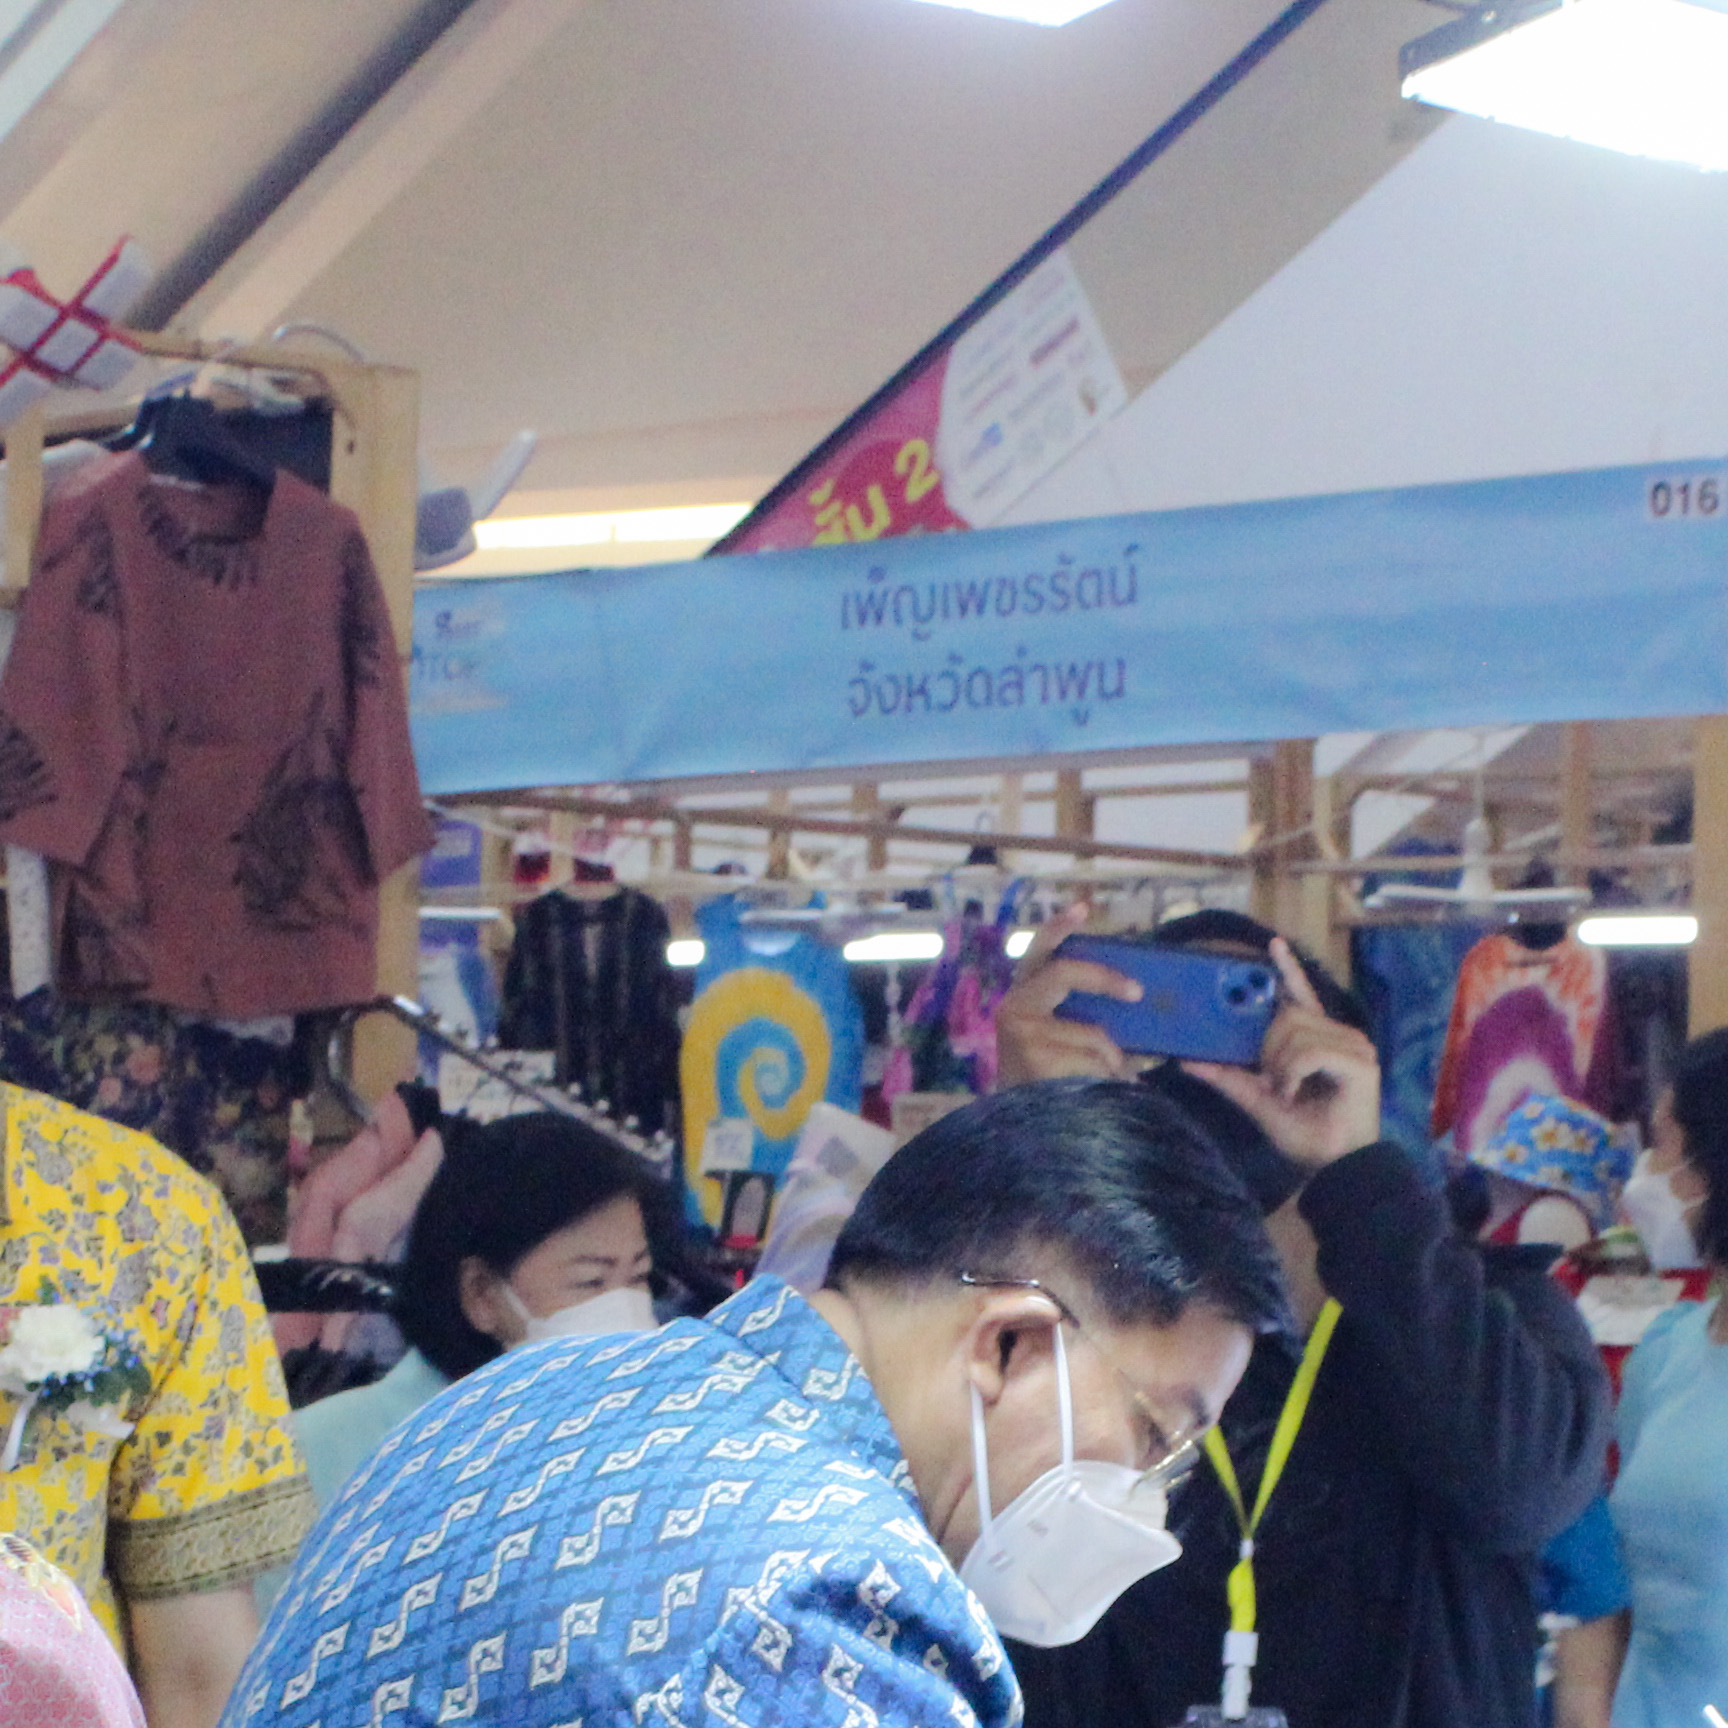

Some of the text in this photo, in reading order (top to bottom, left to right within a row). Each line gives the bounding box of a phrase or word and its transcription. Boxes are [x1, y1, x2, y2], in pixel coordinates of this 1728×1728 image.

[1651, 479, 1720, 517] 016
[848, 646, 1127, 727] จังหวัดลำพูน
